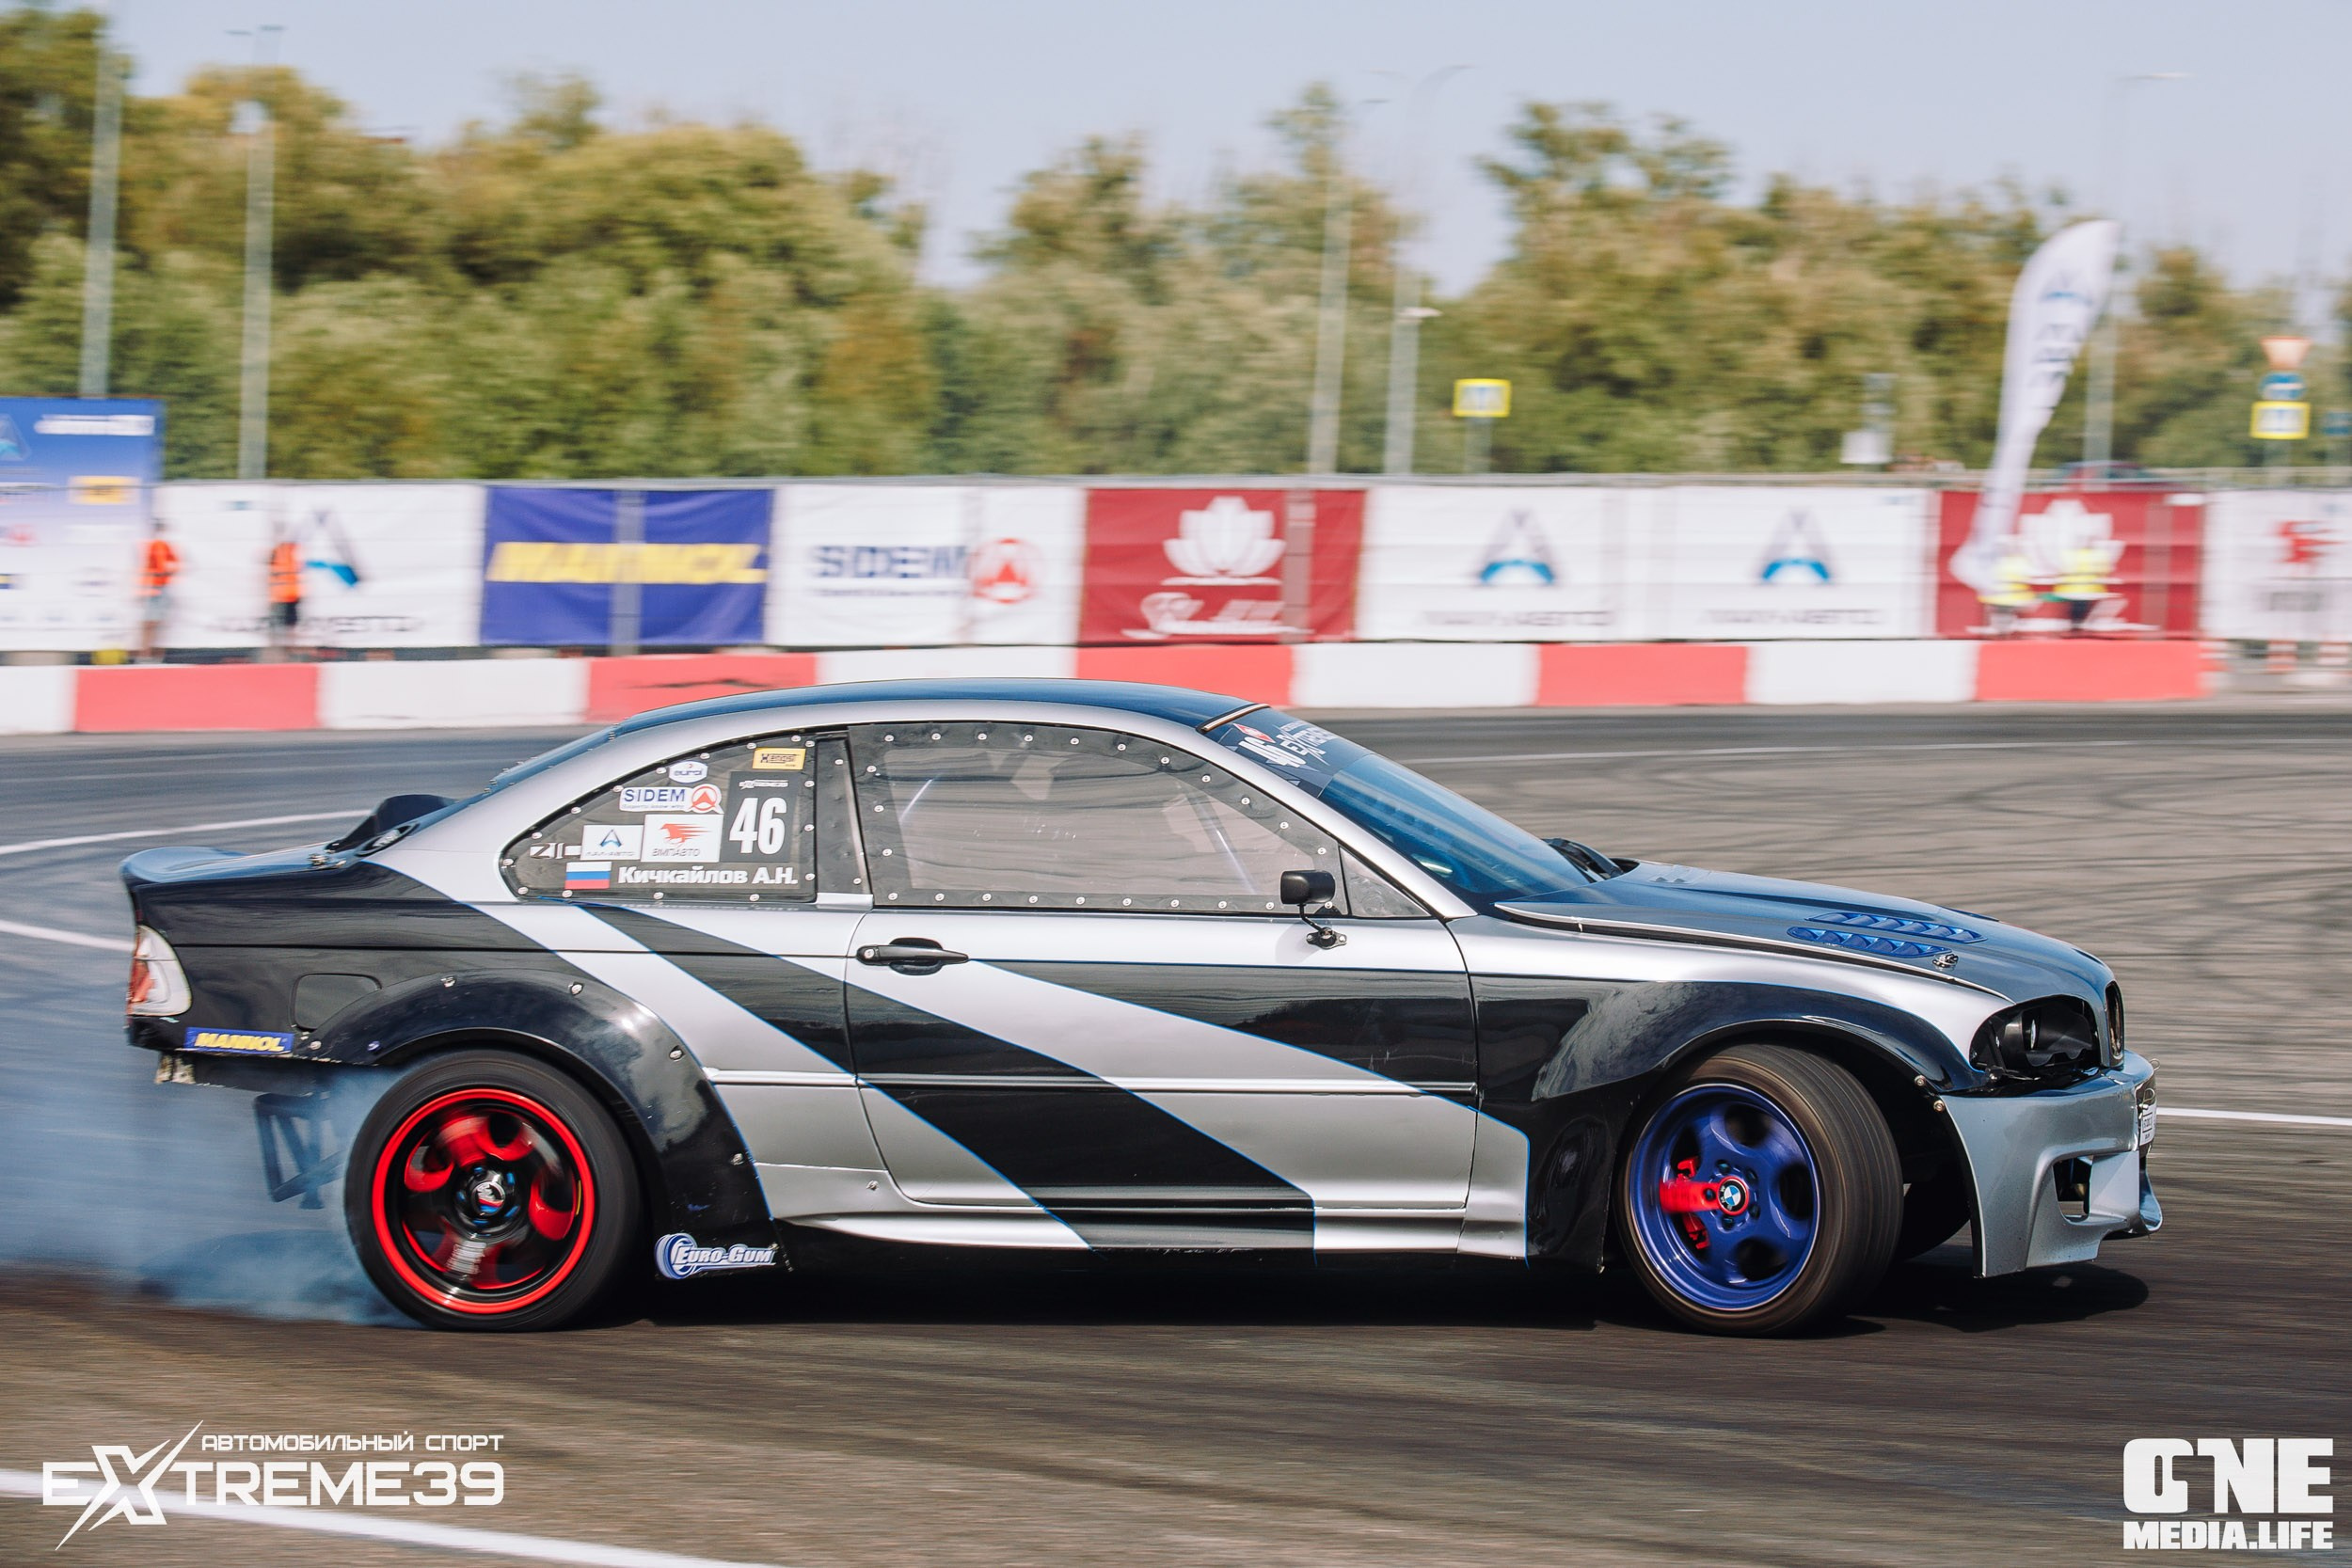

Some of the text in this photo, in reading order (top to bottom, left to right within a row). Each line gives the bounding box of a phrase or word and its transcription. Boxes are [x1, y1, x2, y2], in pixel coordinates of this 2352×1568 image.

[624, 789, 686, 802] SIDEM
[729, 797, 787, 855] 46
[617, 865, 799, 885] Кичкайлов А.Н.
[195, 1033, 286, 1053] MANNOL
